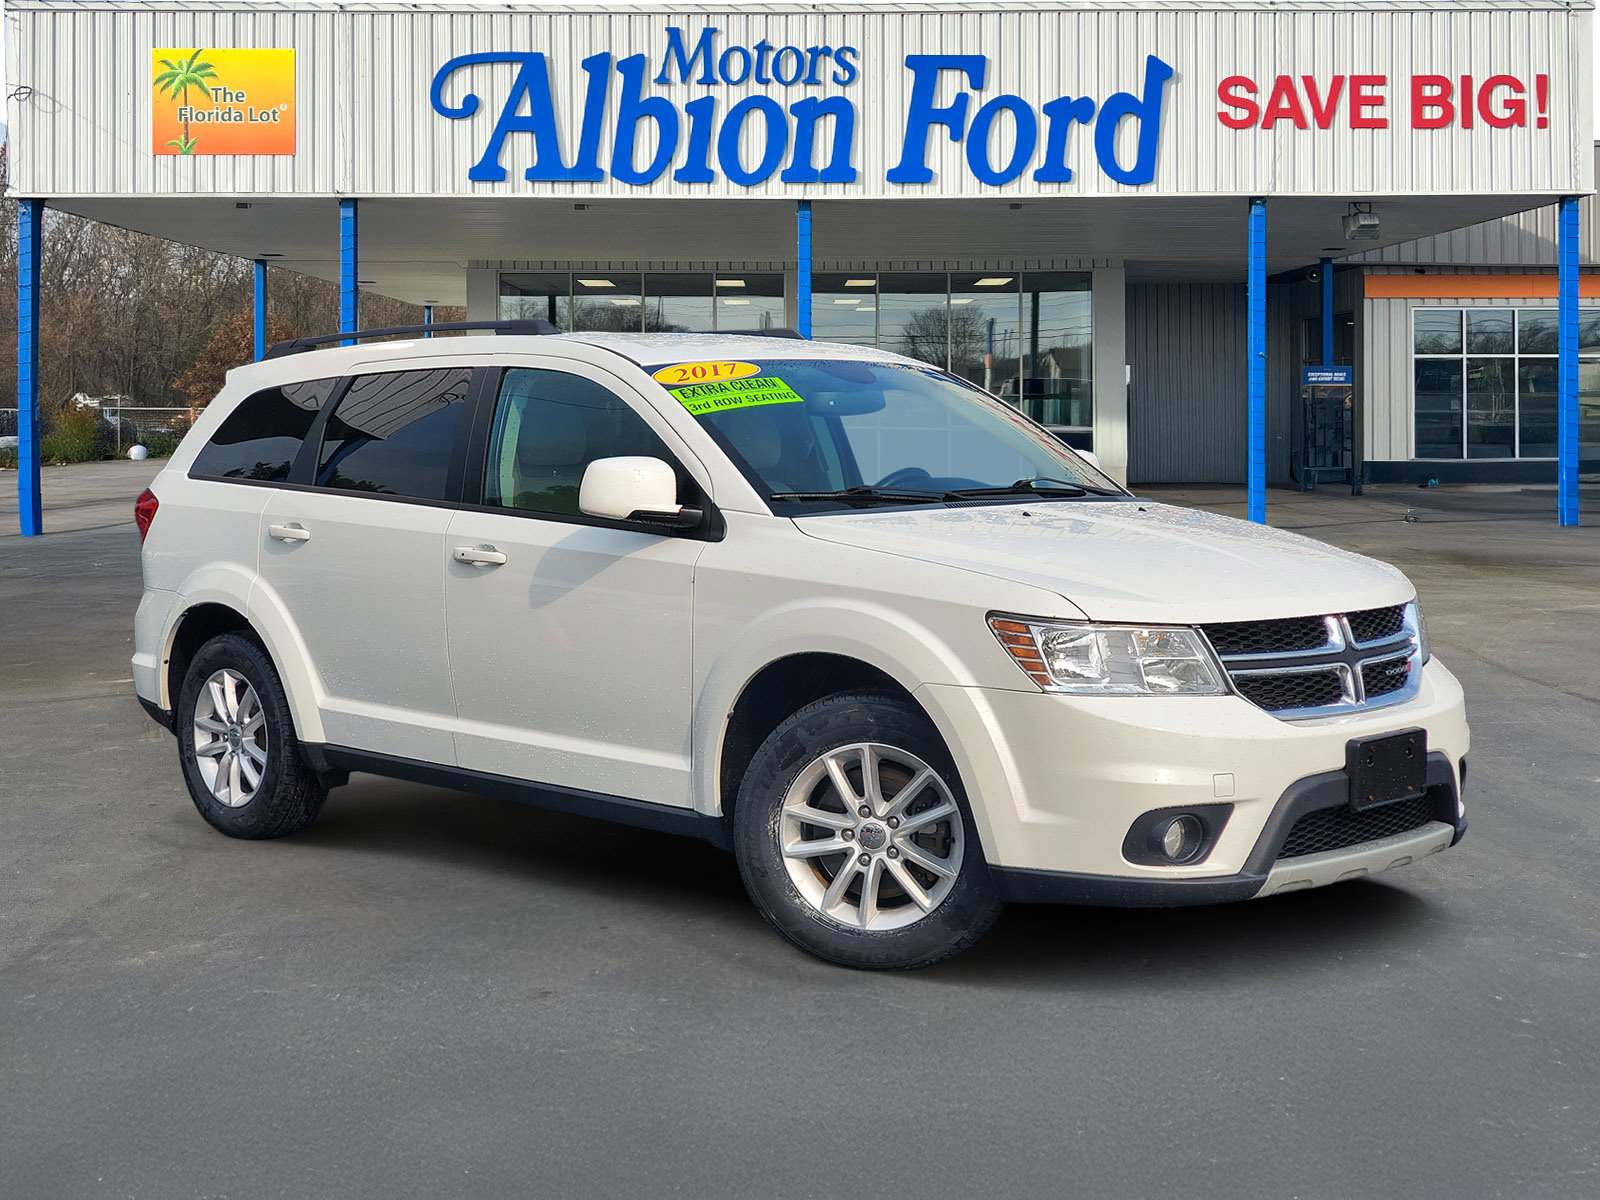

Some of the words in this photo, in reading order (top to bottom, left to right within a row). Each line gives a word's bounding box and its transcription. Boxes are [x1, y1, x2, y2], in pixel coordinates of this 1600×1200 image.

[653, 27, 858, 86] Motors
[211, 87, 246, 103] The
[1217, 74, 1388, 130] SAVE
[1411, 74, 1548, 130] BIG!
[178, 106, 244, 122] Florida
[248, 107, 279, 122] Lot
[430, 51, 857, 186] Albion
[886, 54, 1173, 186] Ford
[673, 363, 737, 382] 2017
[679, 384, 728, 399] EXTRA
[730, 378, 777, 391] CLEAN
[689, 401, 711, 412] 3rd
[714, 395, 742, 407] ROW
[745, 391, 796, 403] SEATING
